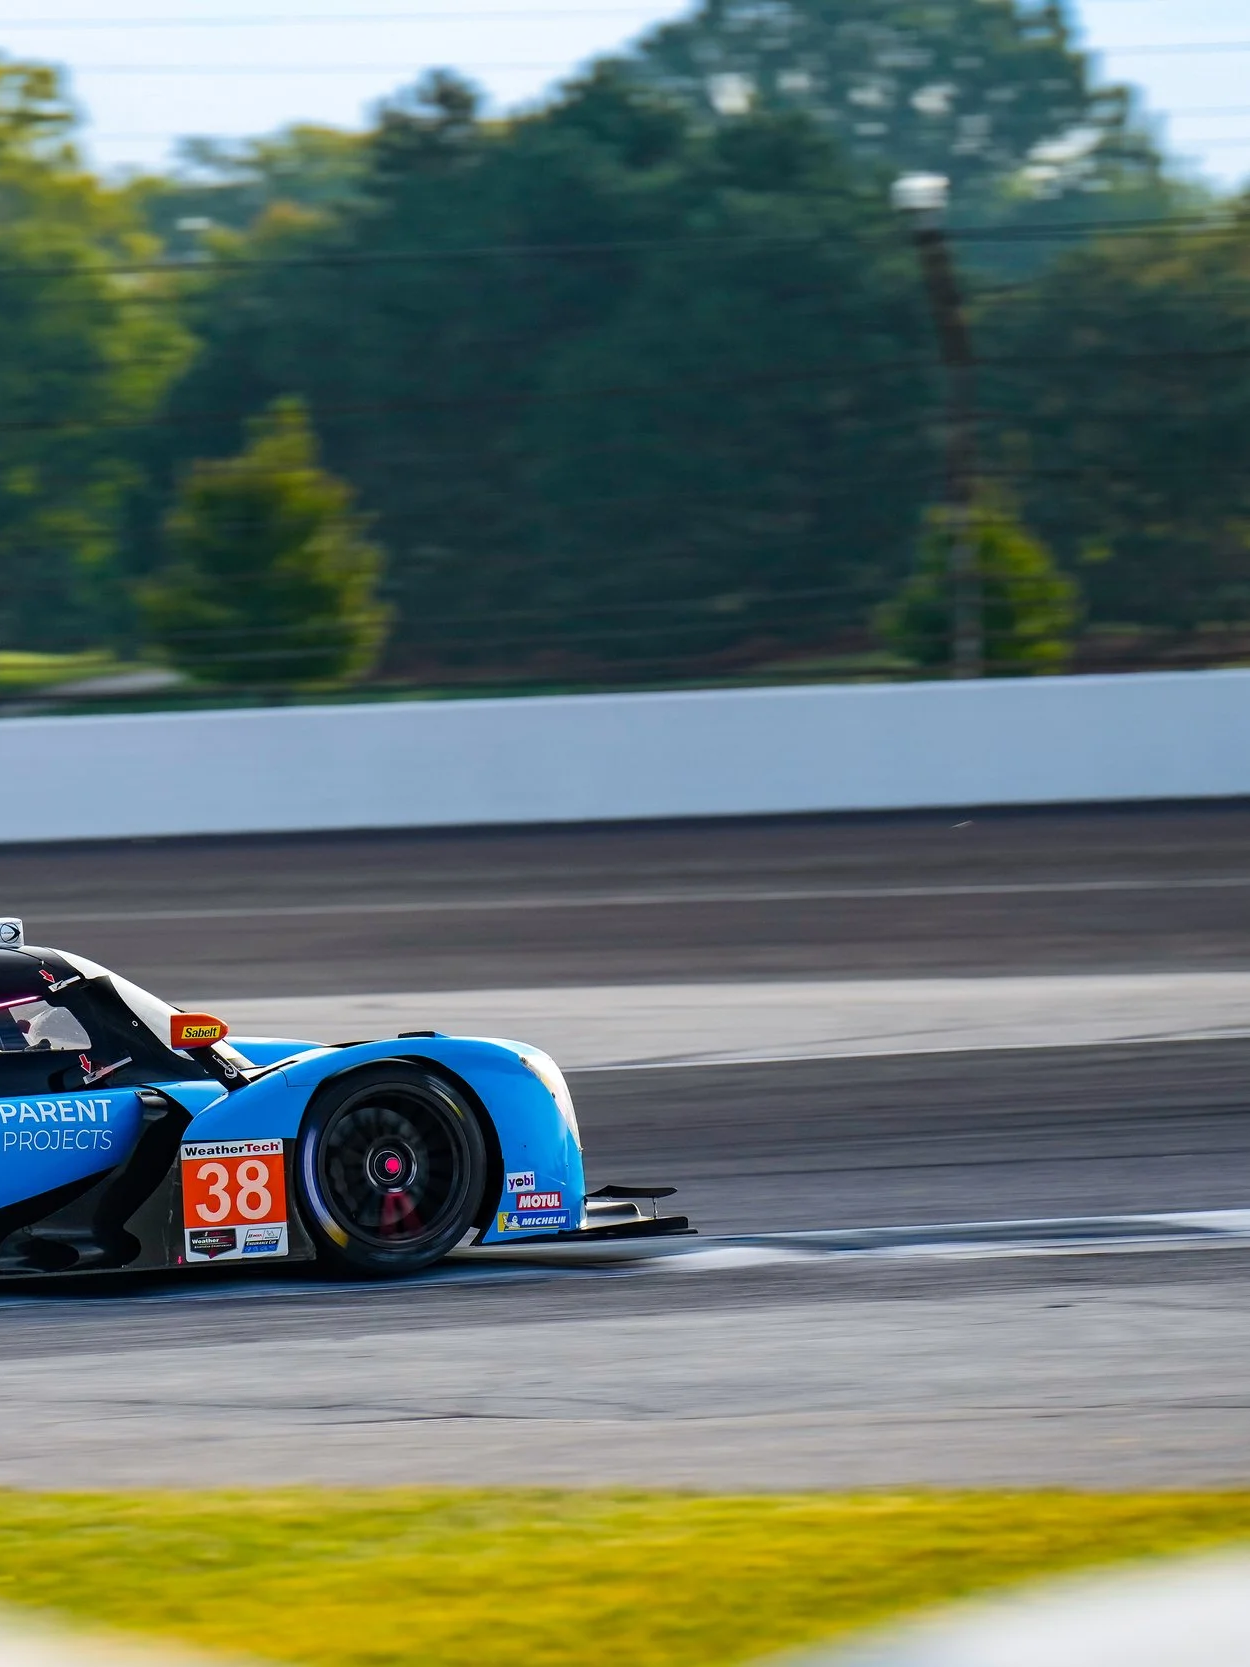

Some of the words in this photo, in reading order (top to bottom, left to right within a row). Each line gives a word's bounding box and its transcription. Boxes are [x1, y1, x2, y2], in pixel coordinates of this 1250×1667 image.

[184, 1026, 217, 1038] Sabelt
[3, 1129, 113, 1152] PROJECTS
[185, 1141, 280, 1157] WeatherTech
[195, 1159, 272, 1223] 38
[519, 1194, 559, 1208] MOTUL
[522, 1216, 566, 1225] MICHELIN
